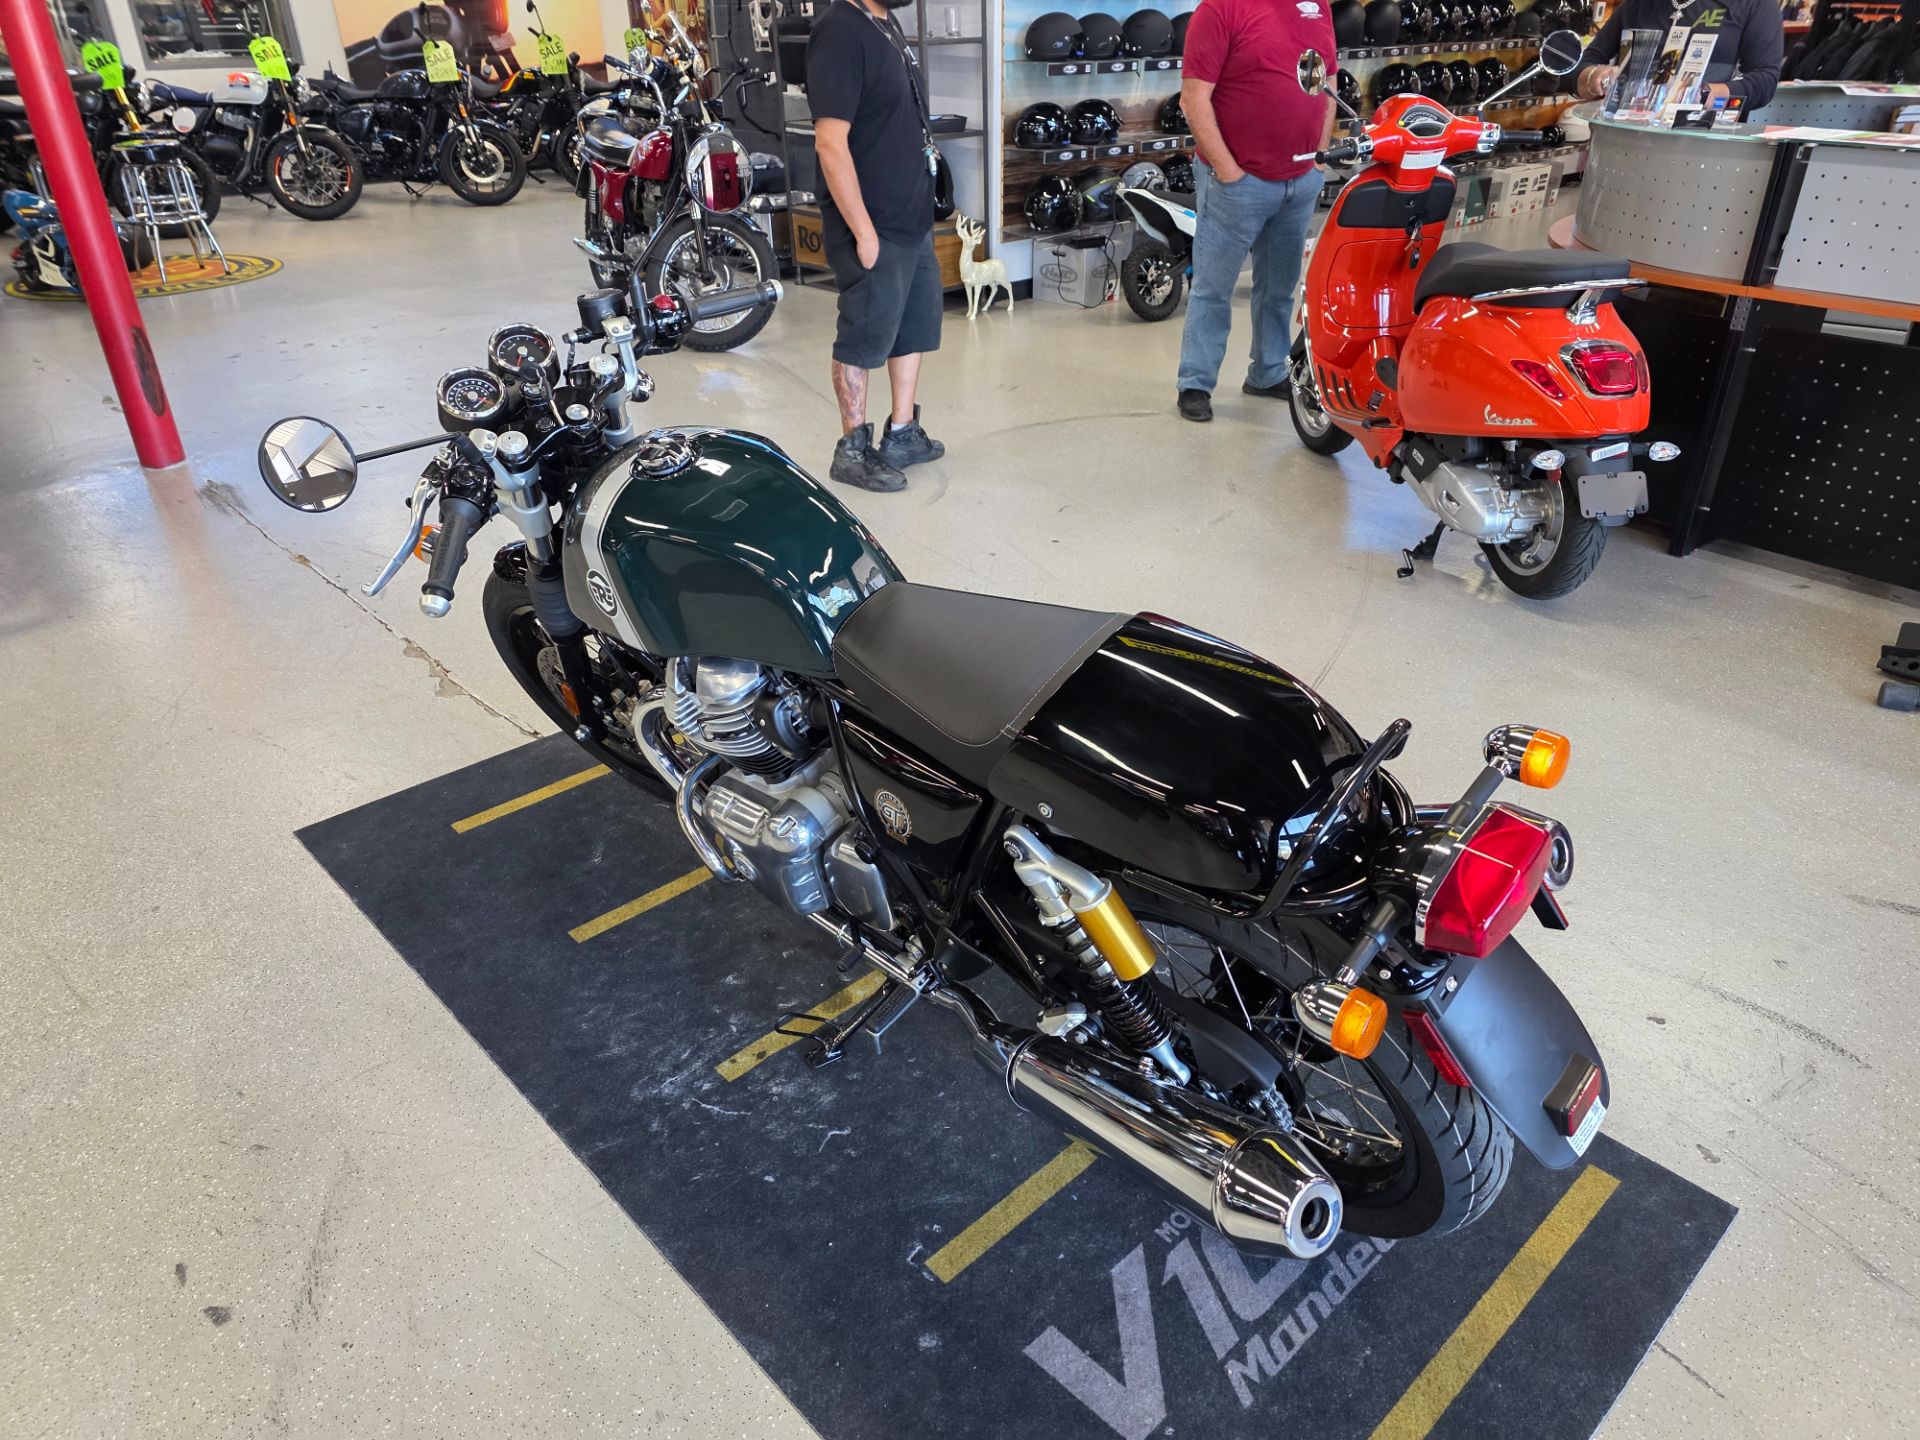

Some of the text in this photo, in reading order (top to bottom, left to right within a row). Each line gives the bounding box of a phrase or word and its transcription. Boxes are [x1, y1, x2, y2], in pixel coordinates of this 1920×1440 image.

[1691, 8, 1726, 28] AE
[539, 40, 564, 60] SALE
[625, 34, 646, 49] SALE
[87, 51, 117, 71] SALE
[254, 44, 282, 63] SALE
[426, 48, 452, 67] SALE
[797, 225, 823, 253] RO
[1483, 404, 1538, 427] Vespa
[1224, 1238, 1398, 1409] Mande
